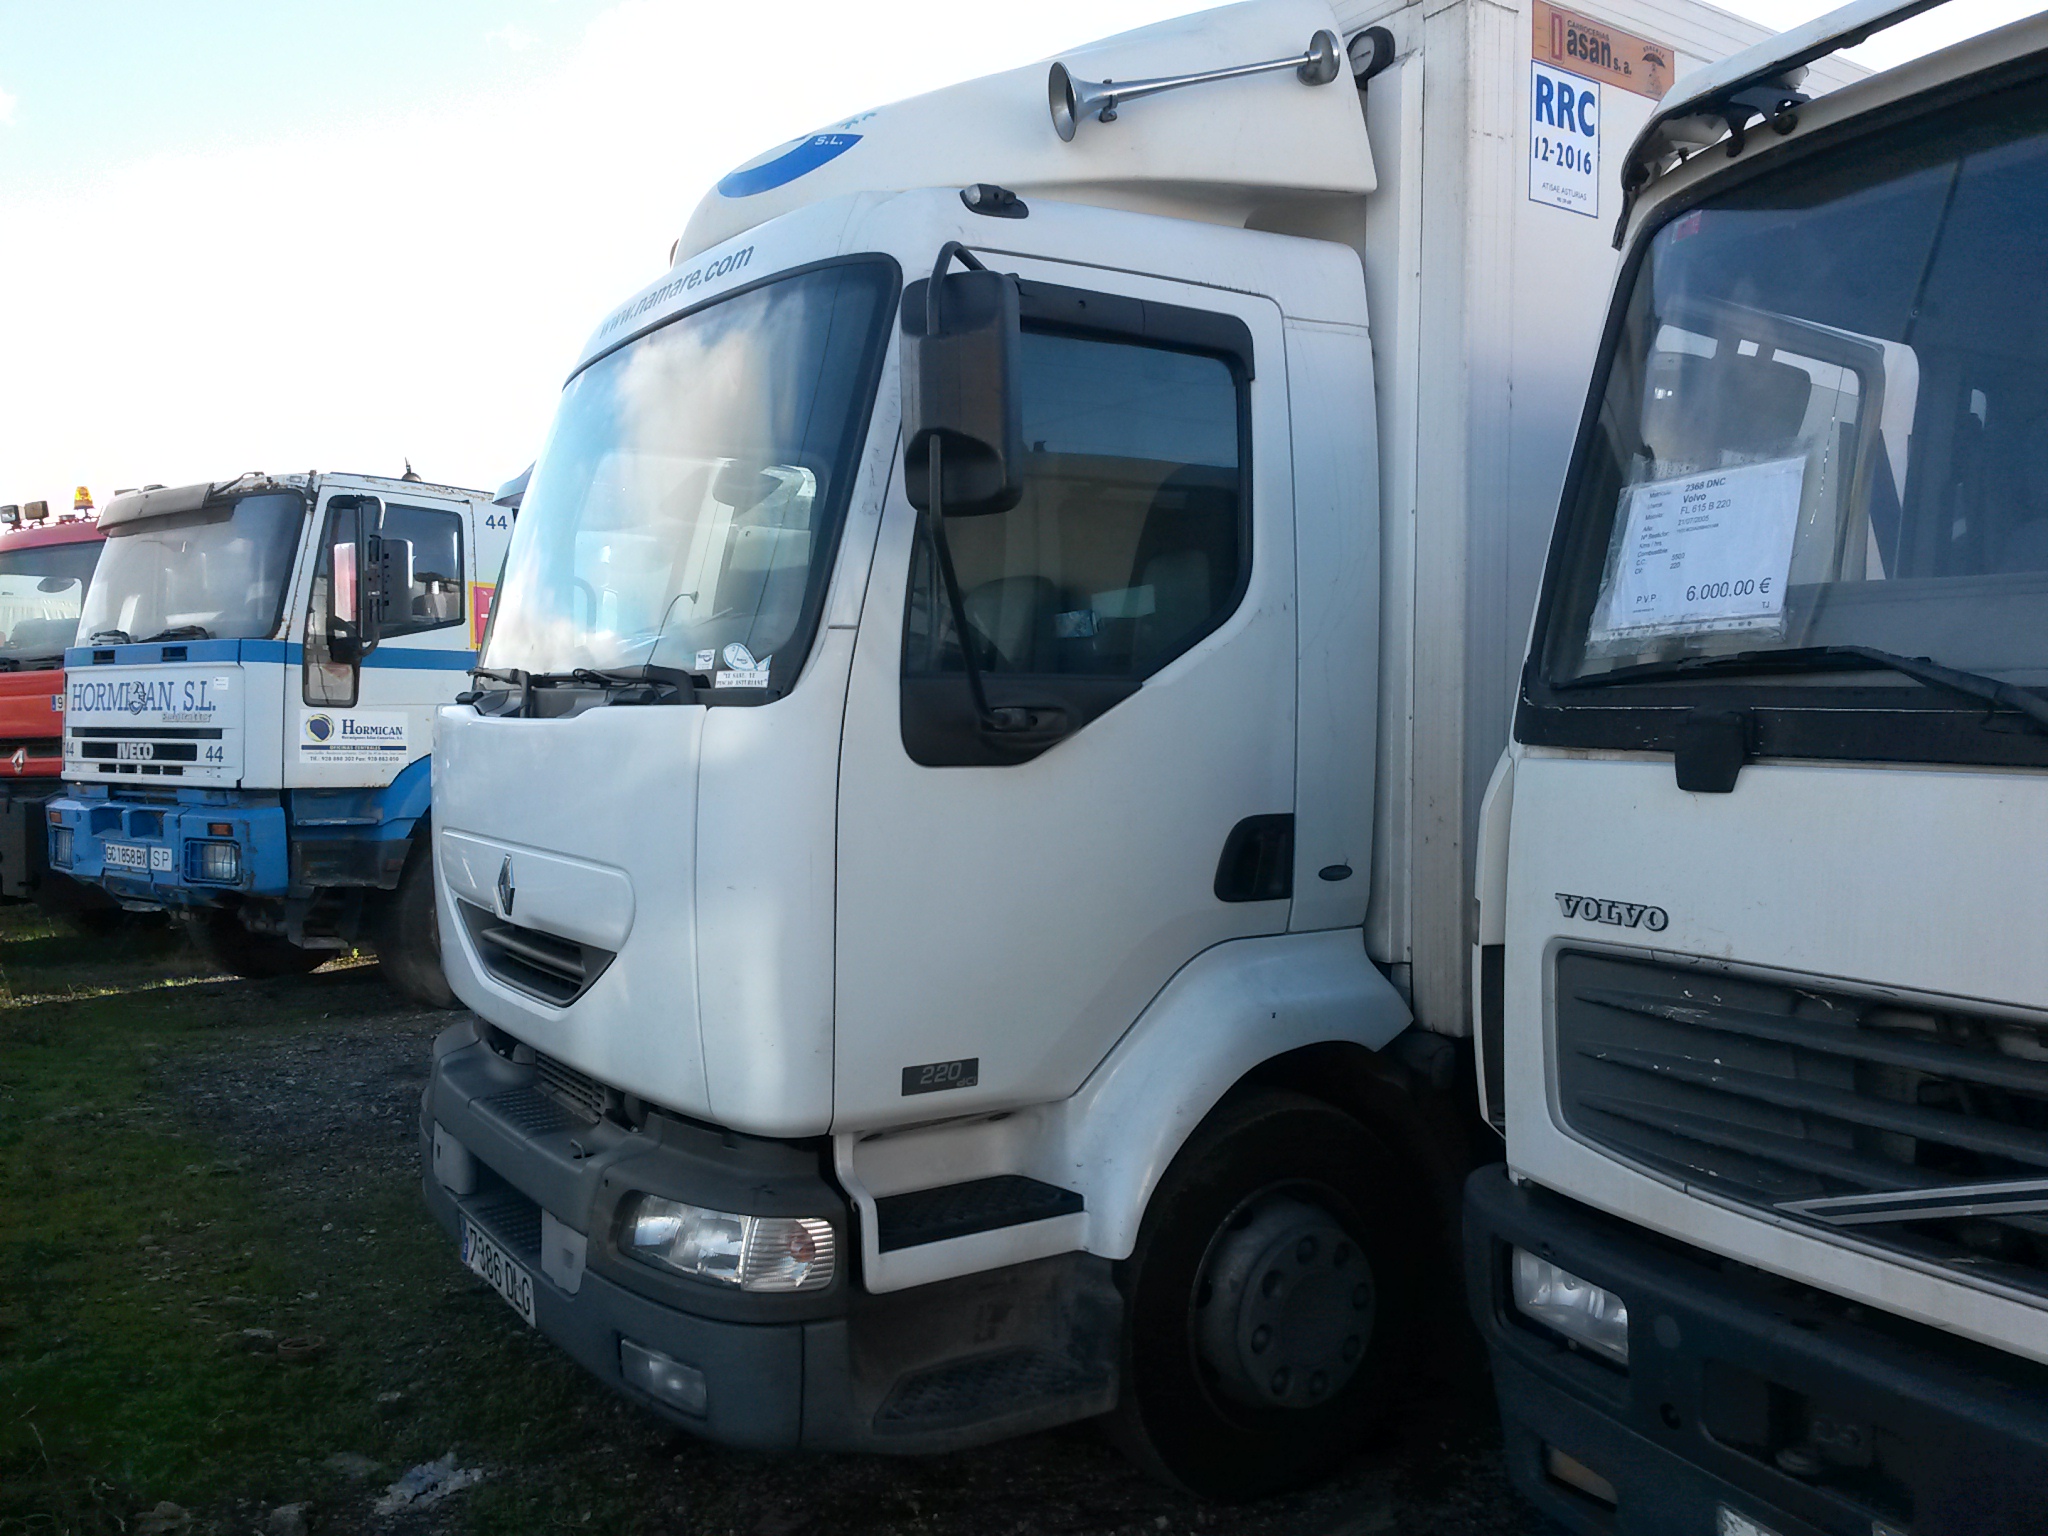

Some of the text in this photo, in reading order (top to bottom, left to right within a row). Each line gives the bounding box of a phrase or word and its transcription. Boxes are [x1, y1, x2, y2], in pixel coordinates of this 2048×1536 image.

[1567, 19, 1609, 41] CARROCERIAS
[1536, 74, 1595, 137] RRC
[815, 136, 844, 146] S.L.
[1534, 136, 1592, 175] 12-2016
[1561, 187, 1587, 201] ASTURIAS
[599, 245, 754, 340] www.namare.com
[1684, 477, 1726, 492] 2368 DNC
[1680, 499, 1731, 515] FL 615 B 220
[1683, 493, 1707, 503] Volvo
[485, 514, 508, 530] 44
[1686, 577, 1771, 601] 6.000.00 €
[71, 680, 217, 714] HORMIAN, S.L.
[341, 719, 403, 735] HORMICAN
[117, 742, 154, 760] IVECO
[205, 745, 224, 762] 44
[153, 850, 170, 867] SP
[1555, 892, 1669, 932] VOLVO
[920, 1062, 962, 1085] 220
[504, 1260, 530, 1316] DLG
